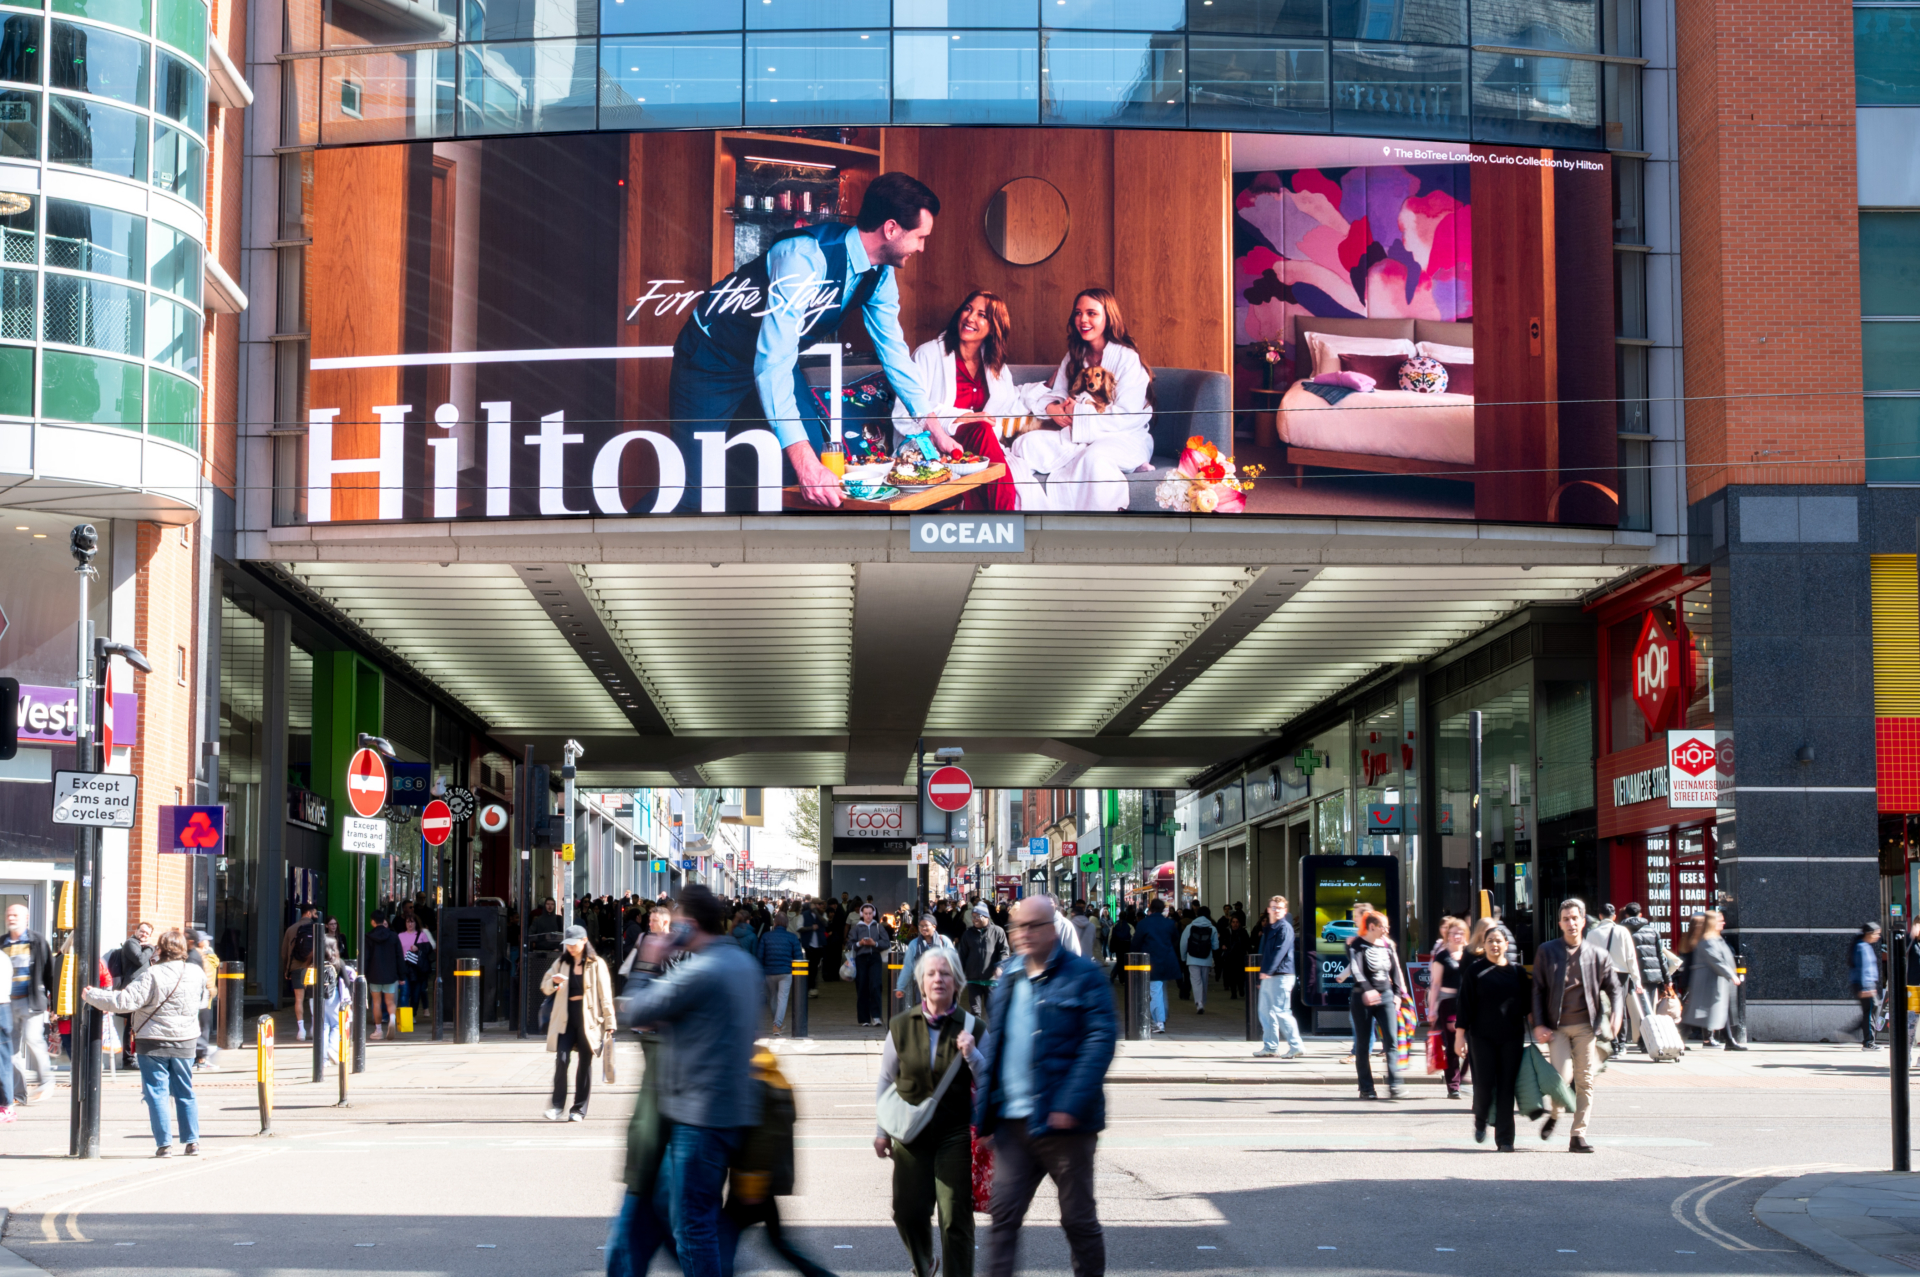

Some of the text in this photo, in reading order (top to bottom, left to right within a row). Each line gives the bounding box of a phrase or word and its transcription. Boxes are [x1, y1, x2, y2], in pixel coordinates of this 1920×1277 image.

[1394, 148, 1604, 171] The BoTree London, Curio Collection by Hilton
[627, 279, 704, 321] For
[705, 276, 762, 317] the
[308, 401, 783, 522] Hilton
[920, 522, 1014, 544] OCEAN
[72, 777, 120, 793] Except
[394, 779, 423, 788] TSB
[1613, 765, 1668, 807] VIETNAMESE STRE
[1672, 780, 1717, 790] VIETNAMESE
[60, 791, 130, 807] ams and
[1674, 791, 1717, 802] STREET EATS
[71, 808, 115, 820] cycles
[451, 808, 473, 822] OFFEE
[848, 805, 902, 829] food
[353, 820, 378, 831] Except
[347, 830, 368, 839] trams
[847, 829, 903, 837] COURT
[353, 841, 376, 849] cycles
[884, 841, 904, 849] LIFTS
[1647, 839, 1664, 850] HOP
[1647, 856, 1664, 867] PHO
[1648, 889, 1671, 900] BANH
[1648, 905, 1666, 916] VIET
[1322, 960, 1345, 973] 0%
